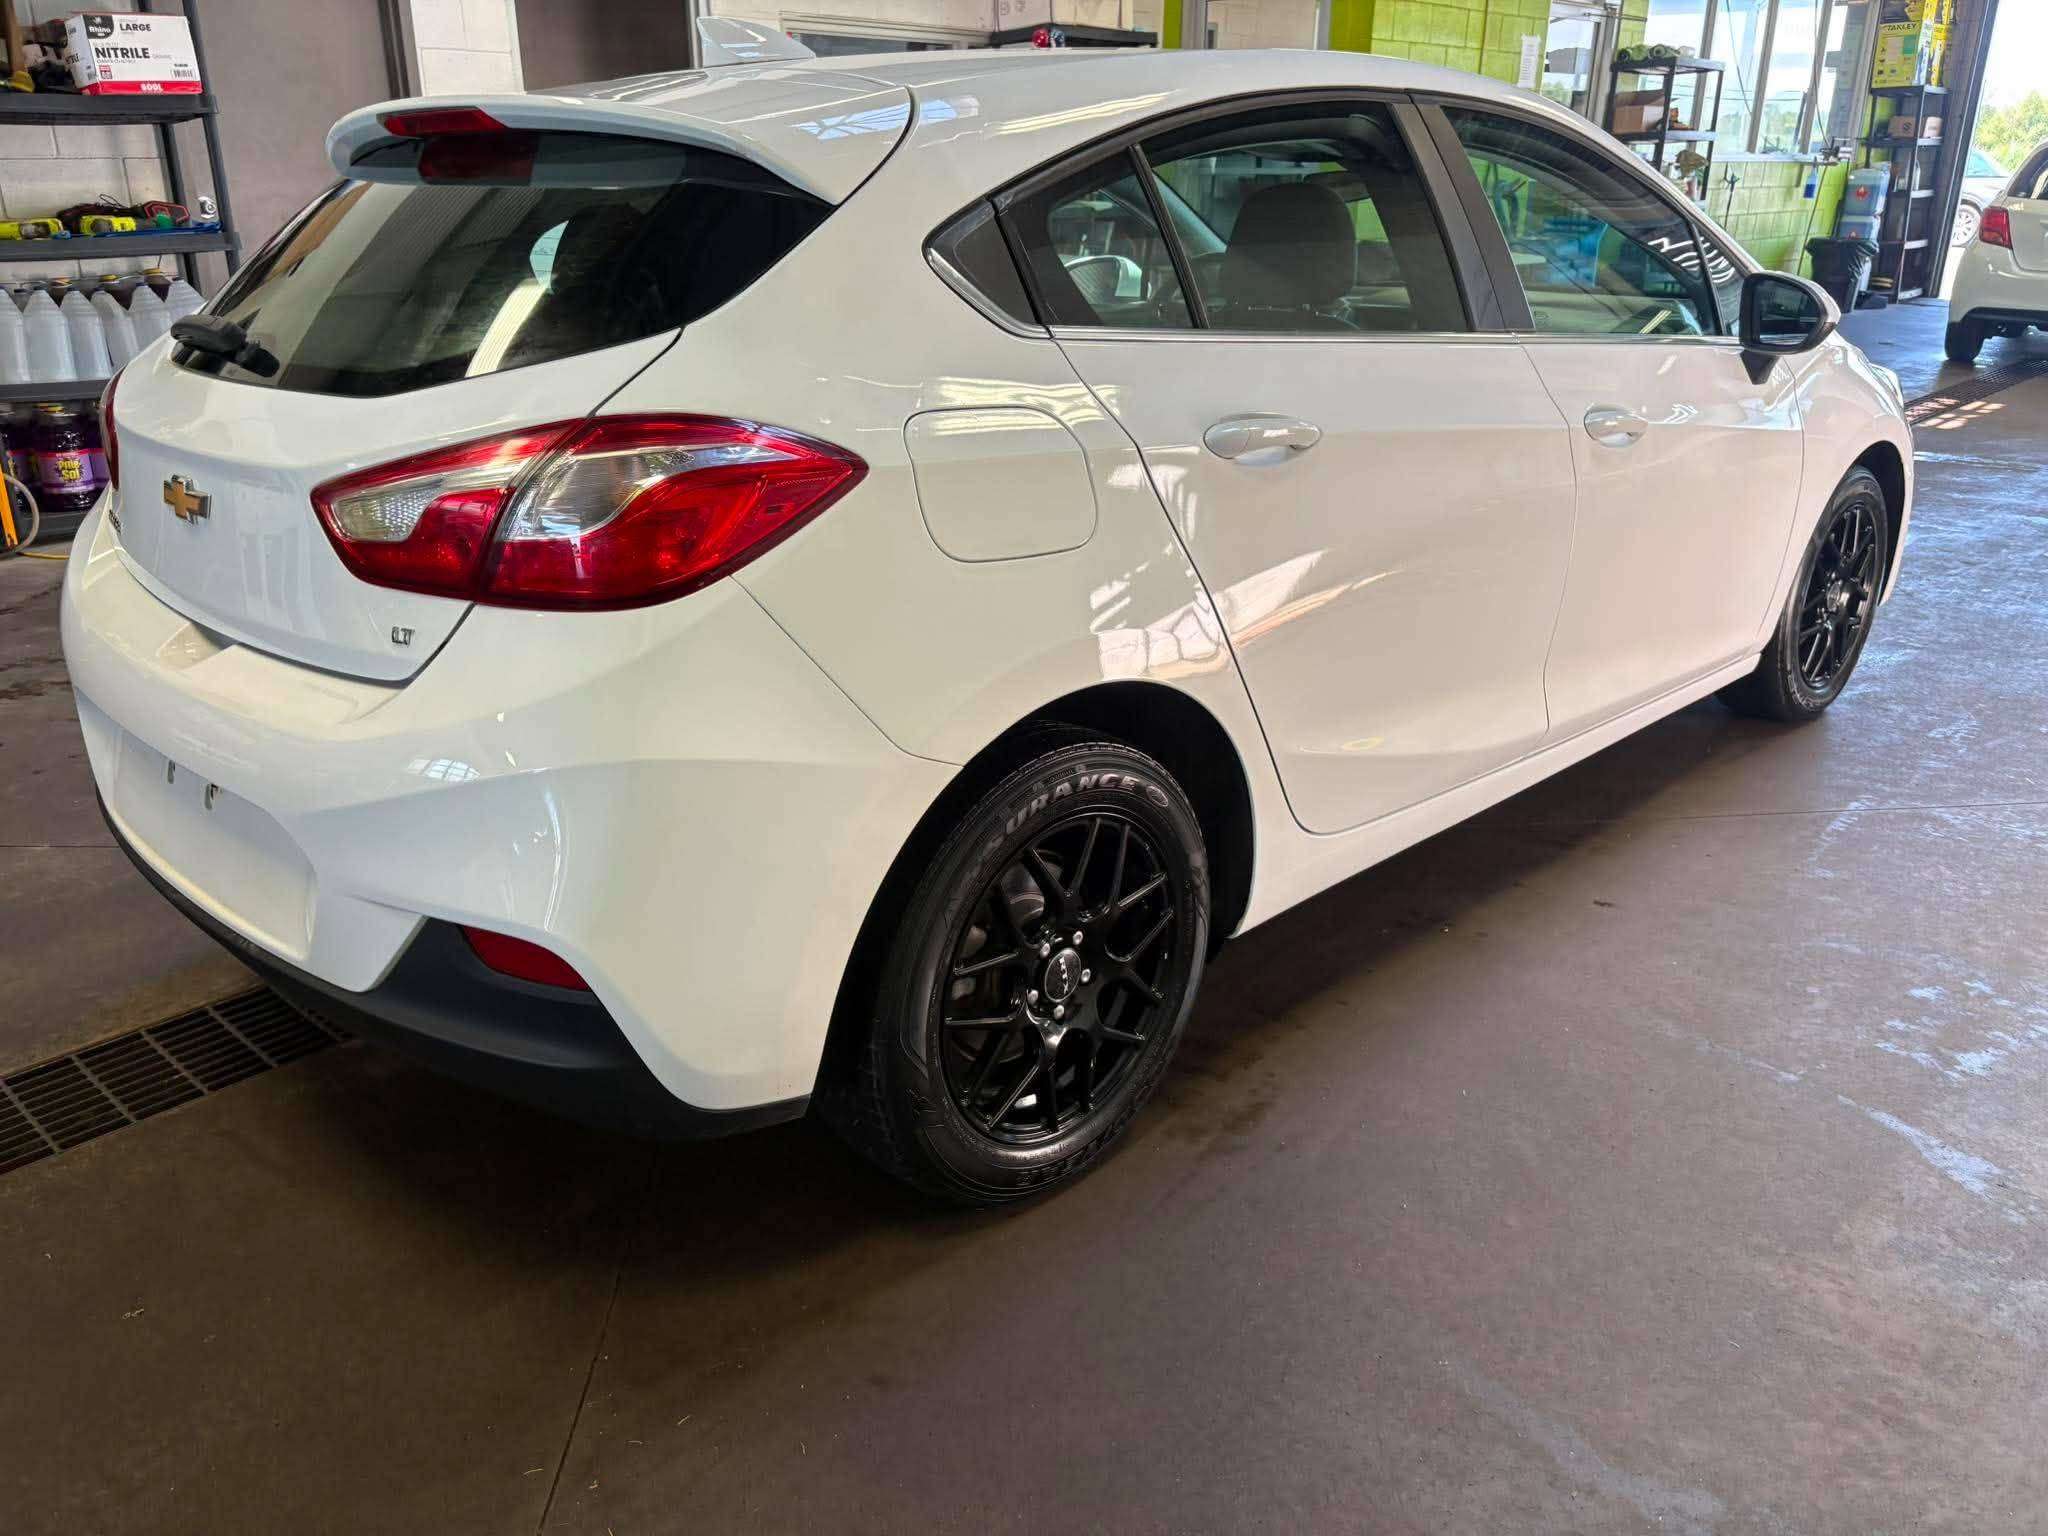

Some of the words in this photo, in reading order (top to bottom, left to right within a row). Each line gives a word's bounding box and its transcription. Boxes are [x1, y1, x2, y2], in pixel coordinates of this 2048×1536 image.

[119, 23, 152, 32] LARGE
[94, 47, 151, 59] NITRILE
[391, 626, 415, 646] LT
